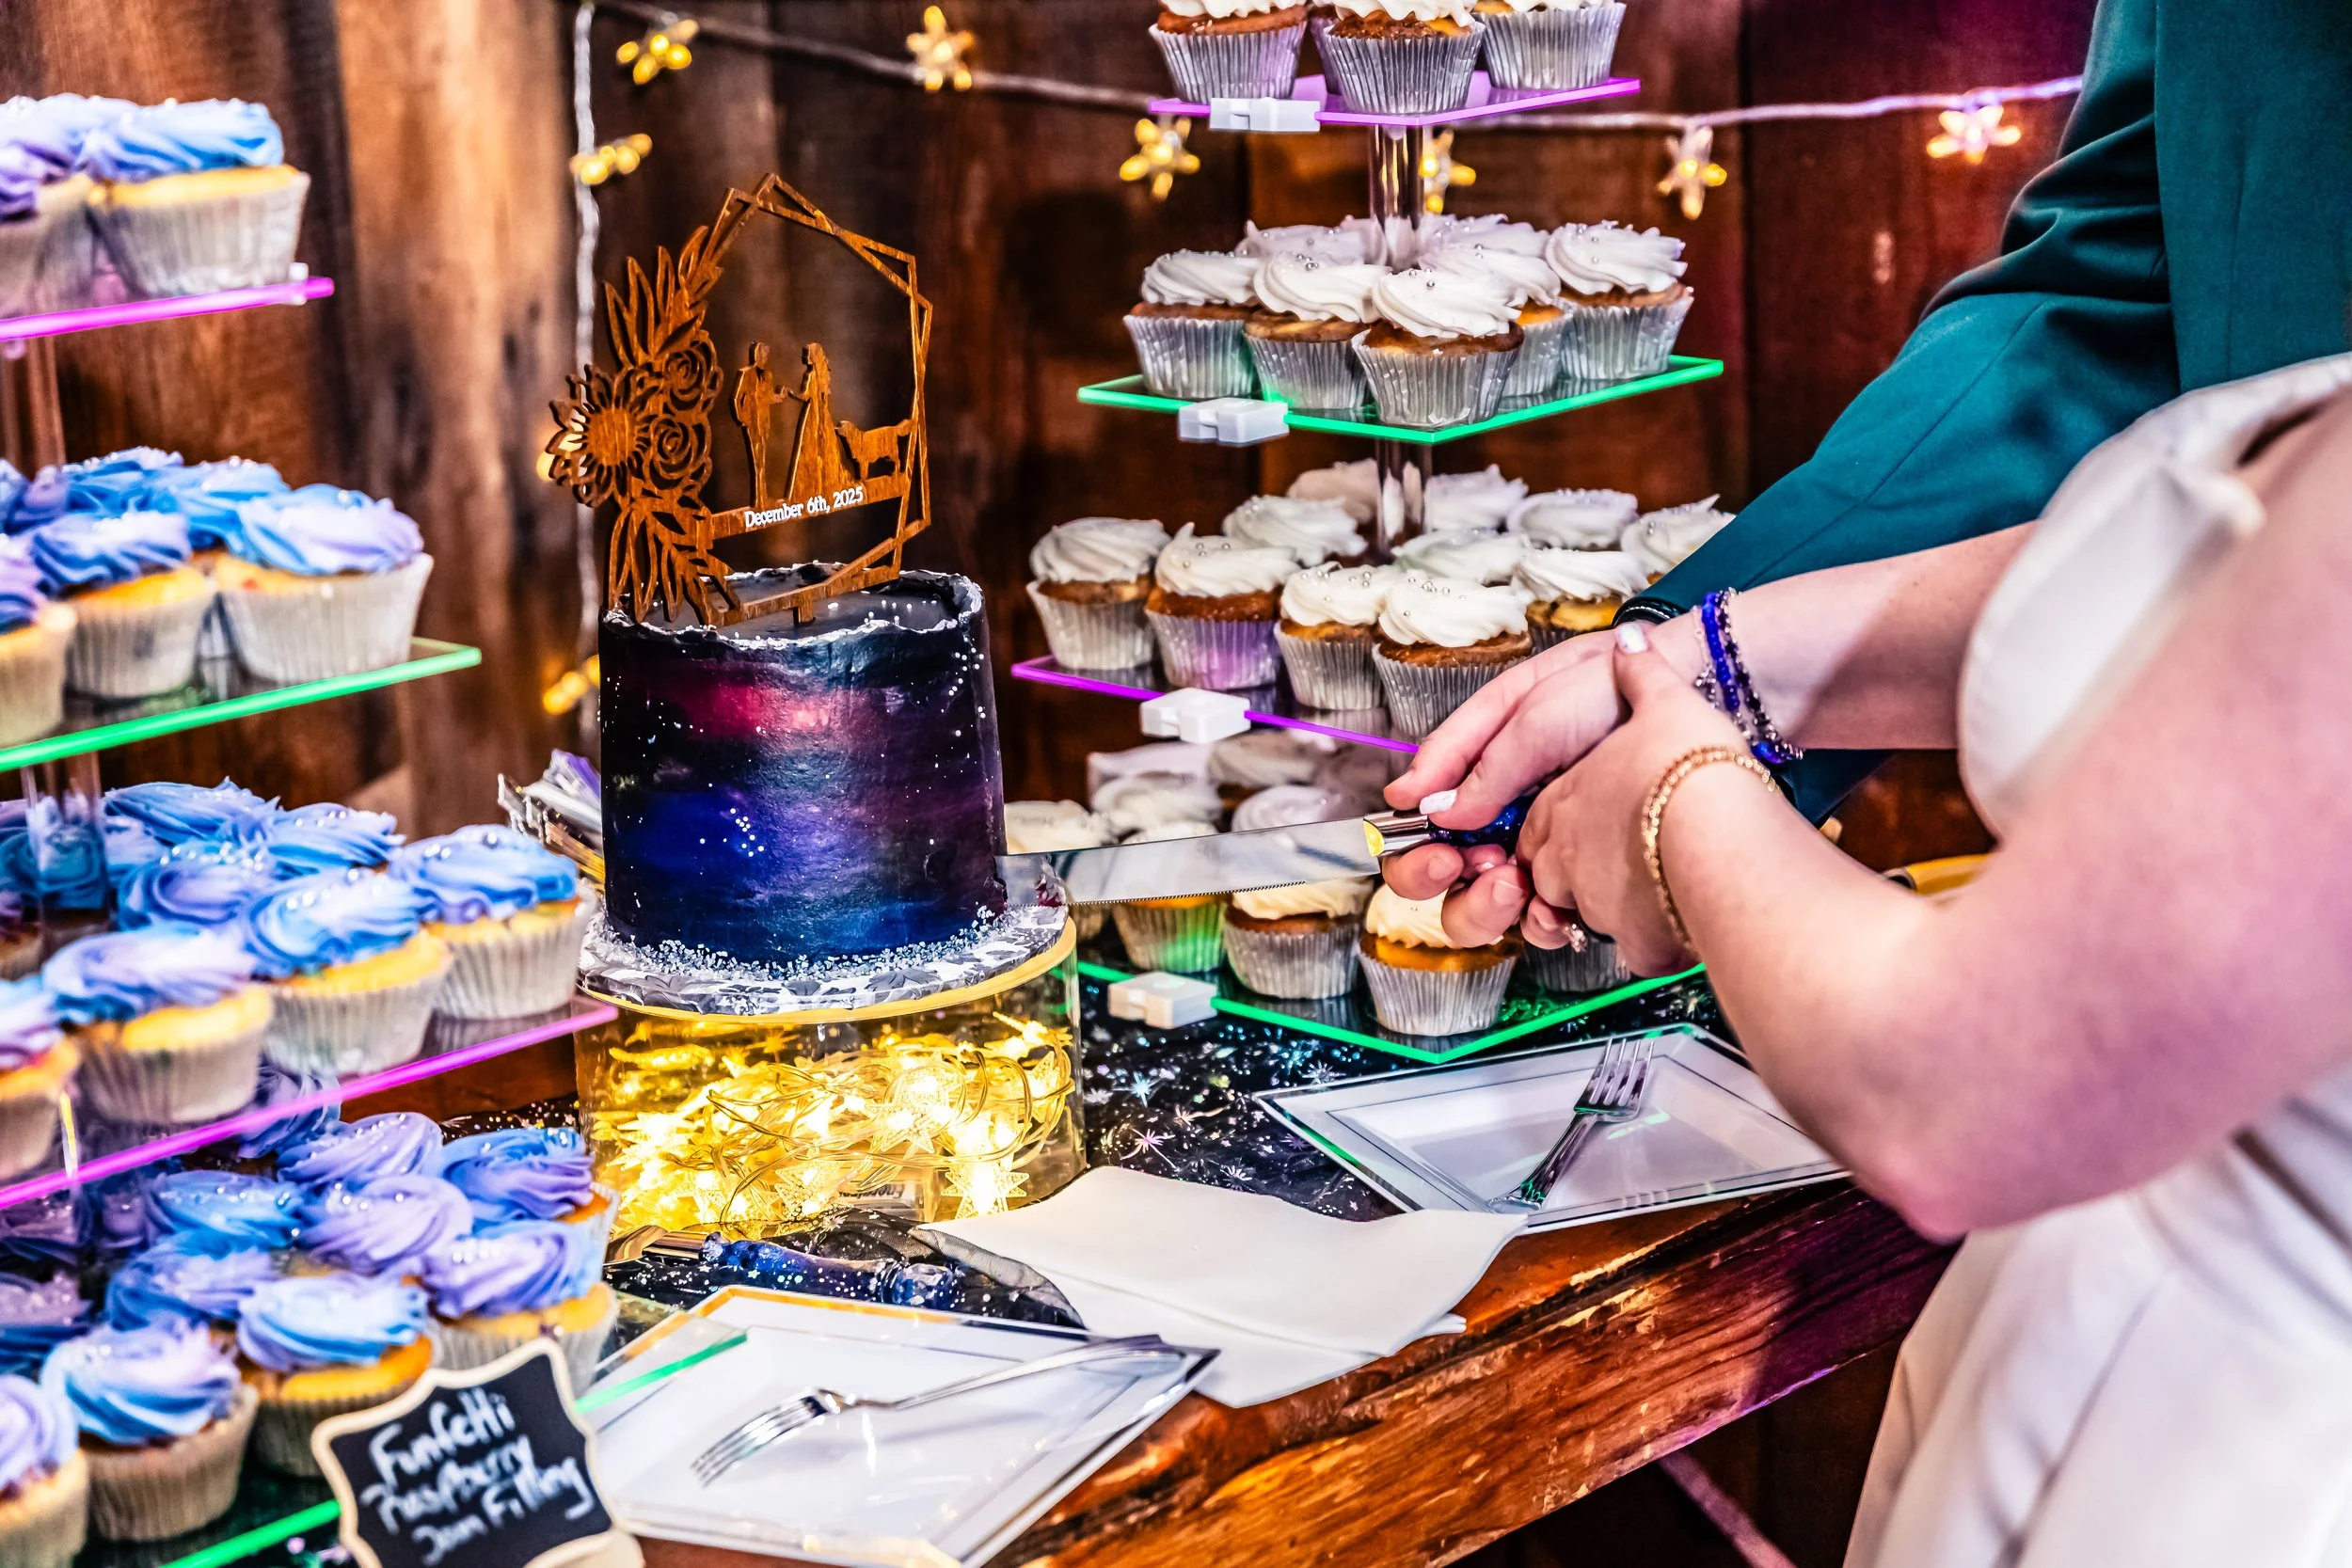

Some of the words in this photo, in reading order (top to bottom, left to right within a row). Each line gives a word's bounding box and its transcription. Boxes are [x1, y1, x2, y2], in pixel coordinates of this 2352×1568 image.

[744, 502, 803, 528] December
[807, 495, 830, 514] 6th,
[833, 485, 864, 509] 2025
[369, 1386, 516, 1488] Funfetti
